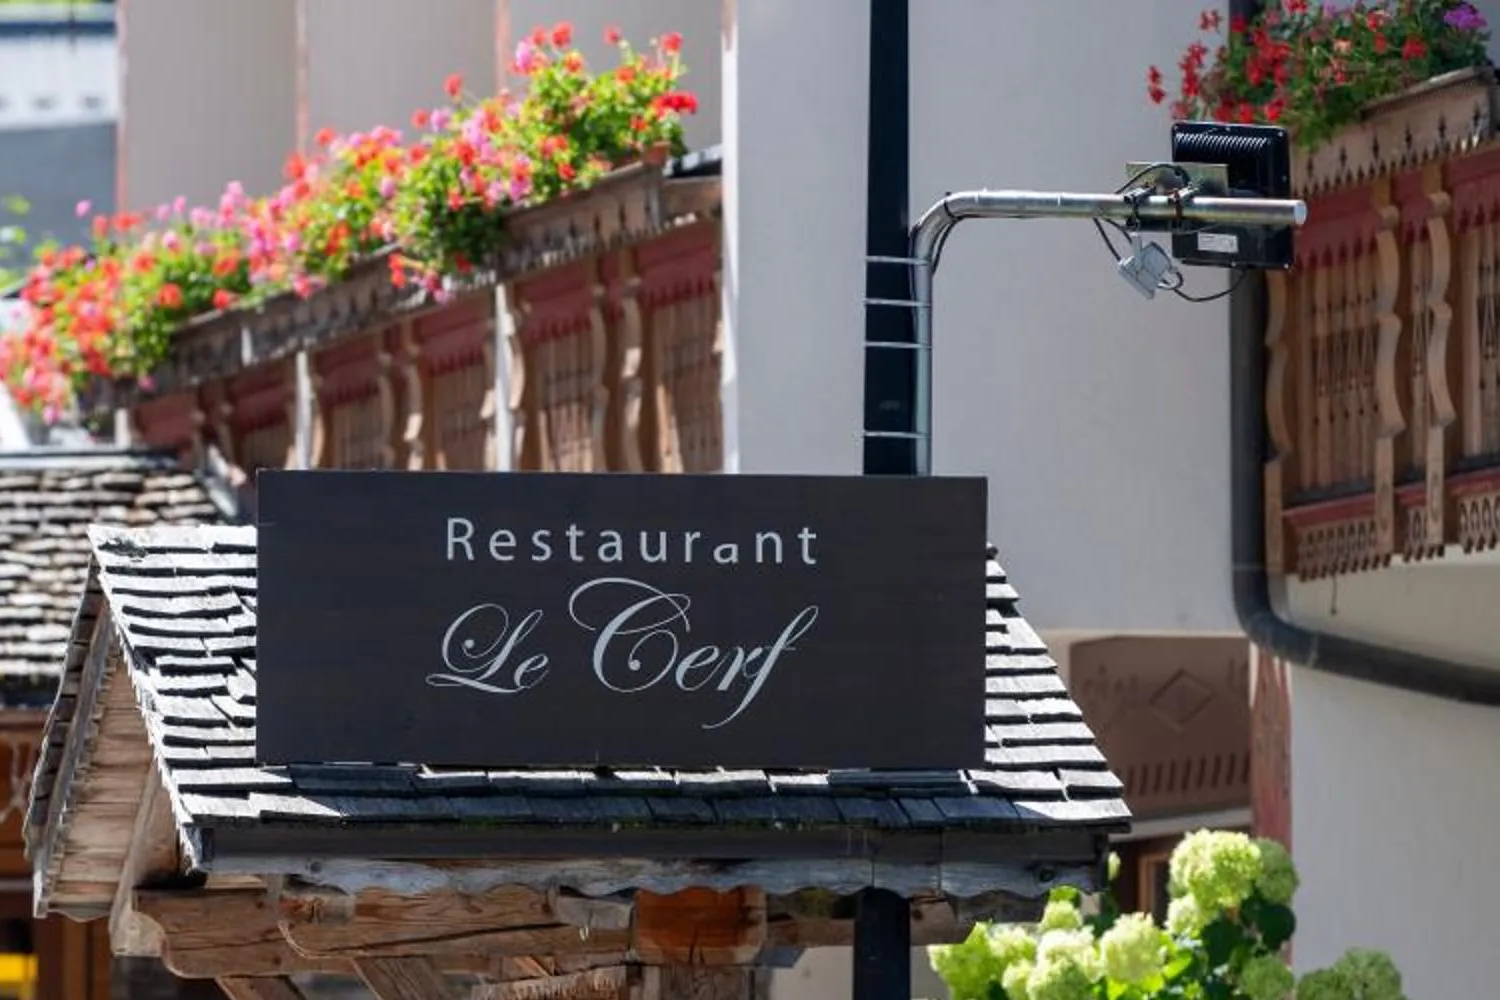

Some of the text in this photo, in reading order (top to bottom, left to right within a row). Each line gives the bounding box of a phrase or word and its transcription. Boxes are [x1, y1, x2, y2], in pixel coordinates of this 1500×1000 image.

[446, 517, 818, 565] Restaurant
[425, 576, 819, 730] Le Cerf
